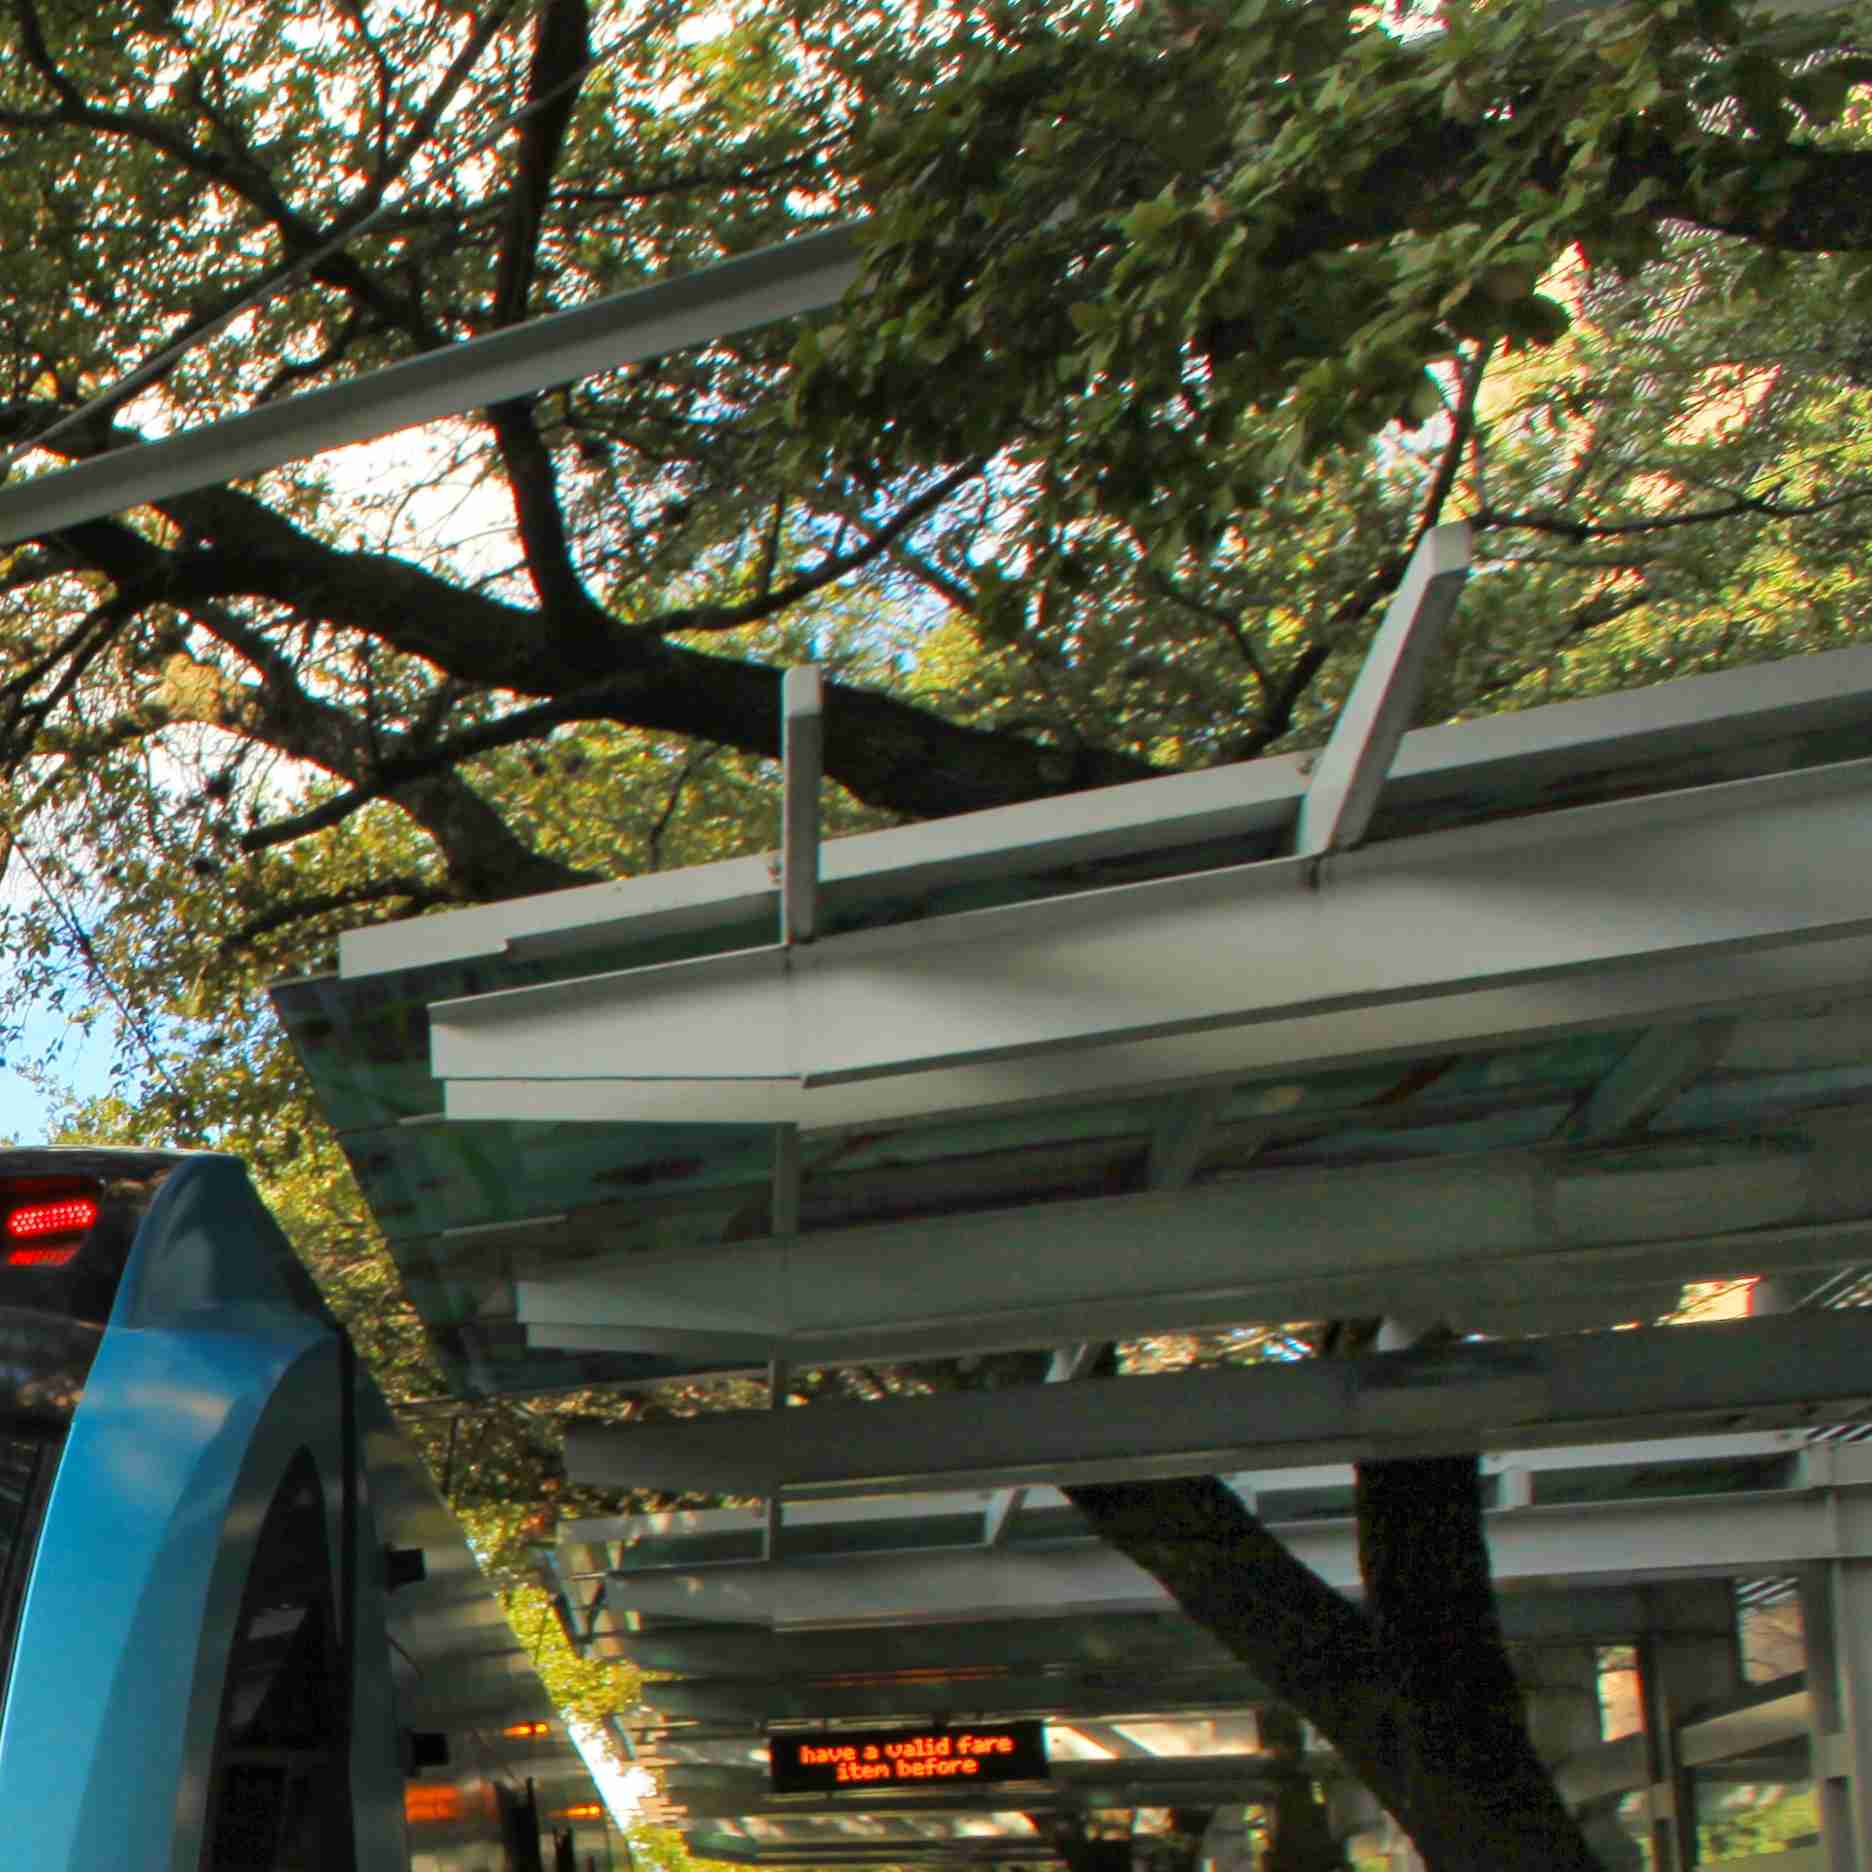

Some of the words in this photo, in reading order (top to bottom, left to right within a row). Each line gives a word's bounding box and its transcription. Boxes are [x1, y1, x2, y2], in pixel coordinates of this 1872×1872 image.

[800, 1745, 857, 1765] have
[863, 1745, 879, 1760] a
[885, 1737, 950, 1758] valid
[957, 1735, 1013, 1755] fare
[896, 1758, 979, 1776] before
